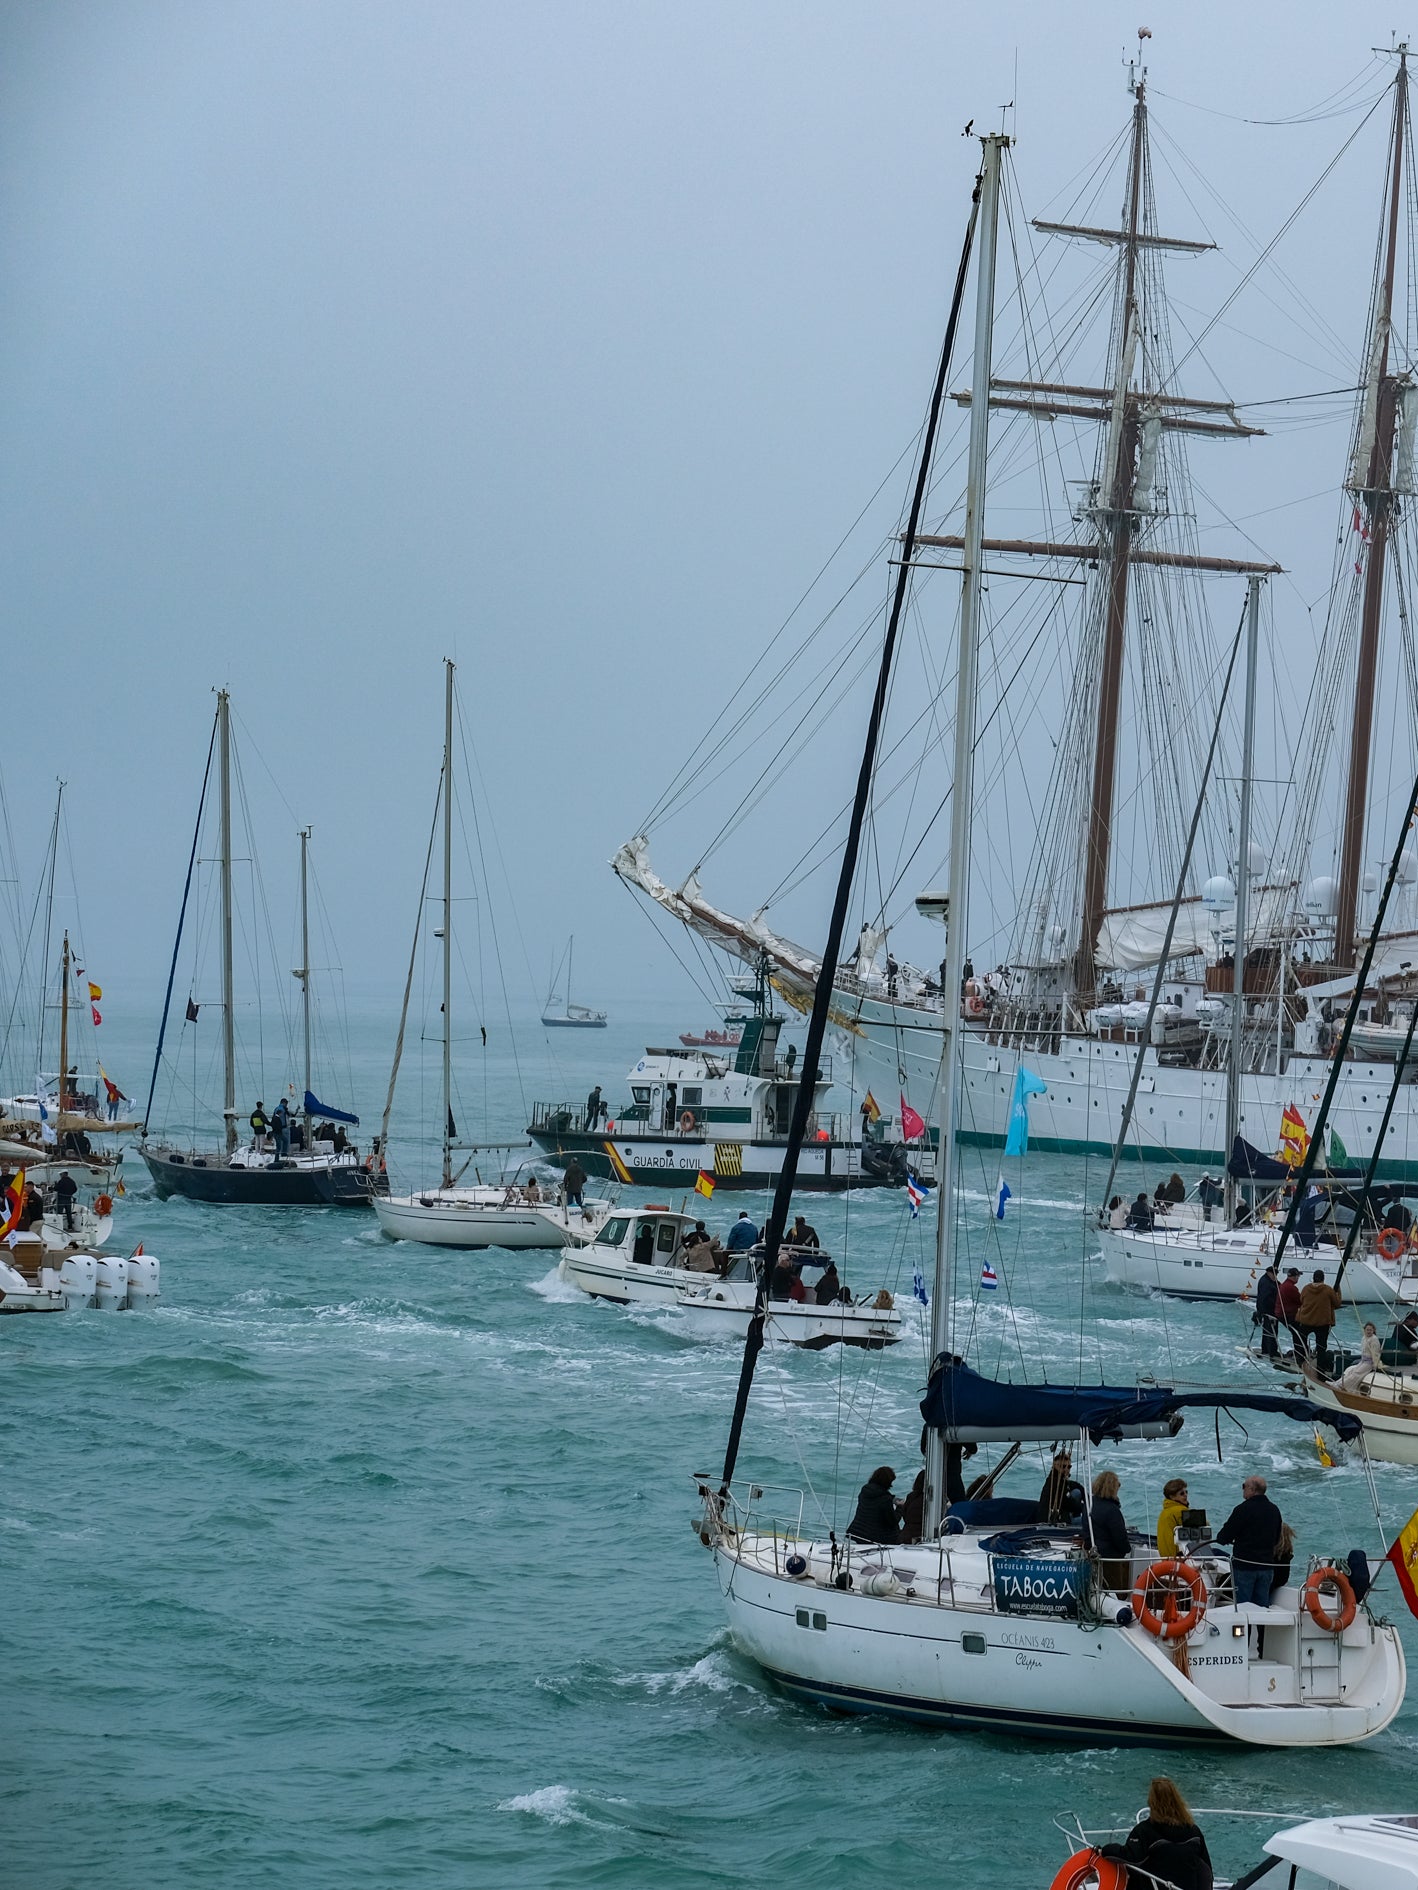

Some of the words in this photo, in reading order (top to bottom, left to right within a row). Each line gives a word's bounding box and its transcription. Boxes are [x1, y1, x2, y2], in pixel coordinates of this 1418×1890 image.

[633, 1156, 675, 1168] GUARDIA
[679, 1158, 703, 1169] CIVIL
[996, 1562, 1023, 1571] ESCUELA
[1036, 1565, 1078, 1573] NAVEGACION
[1000, 1575, 1077, 1600] TABOGA
[1040, 1636, 1055, 1650] 423
